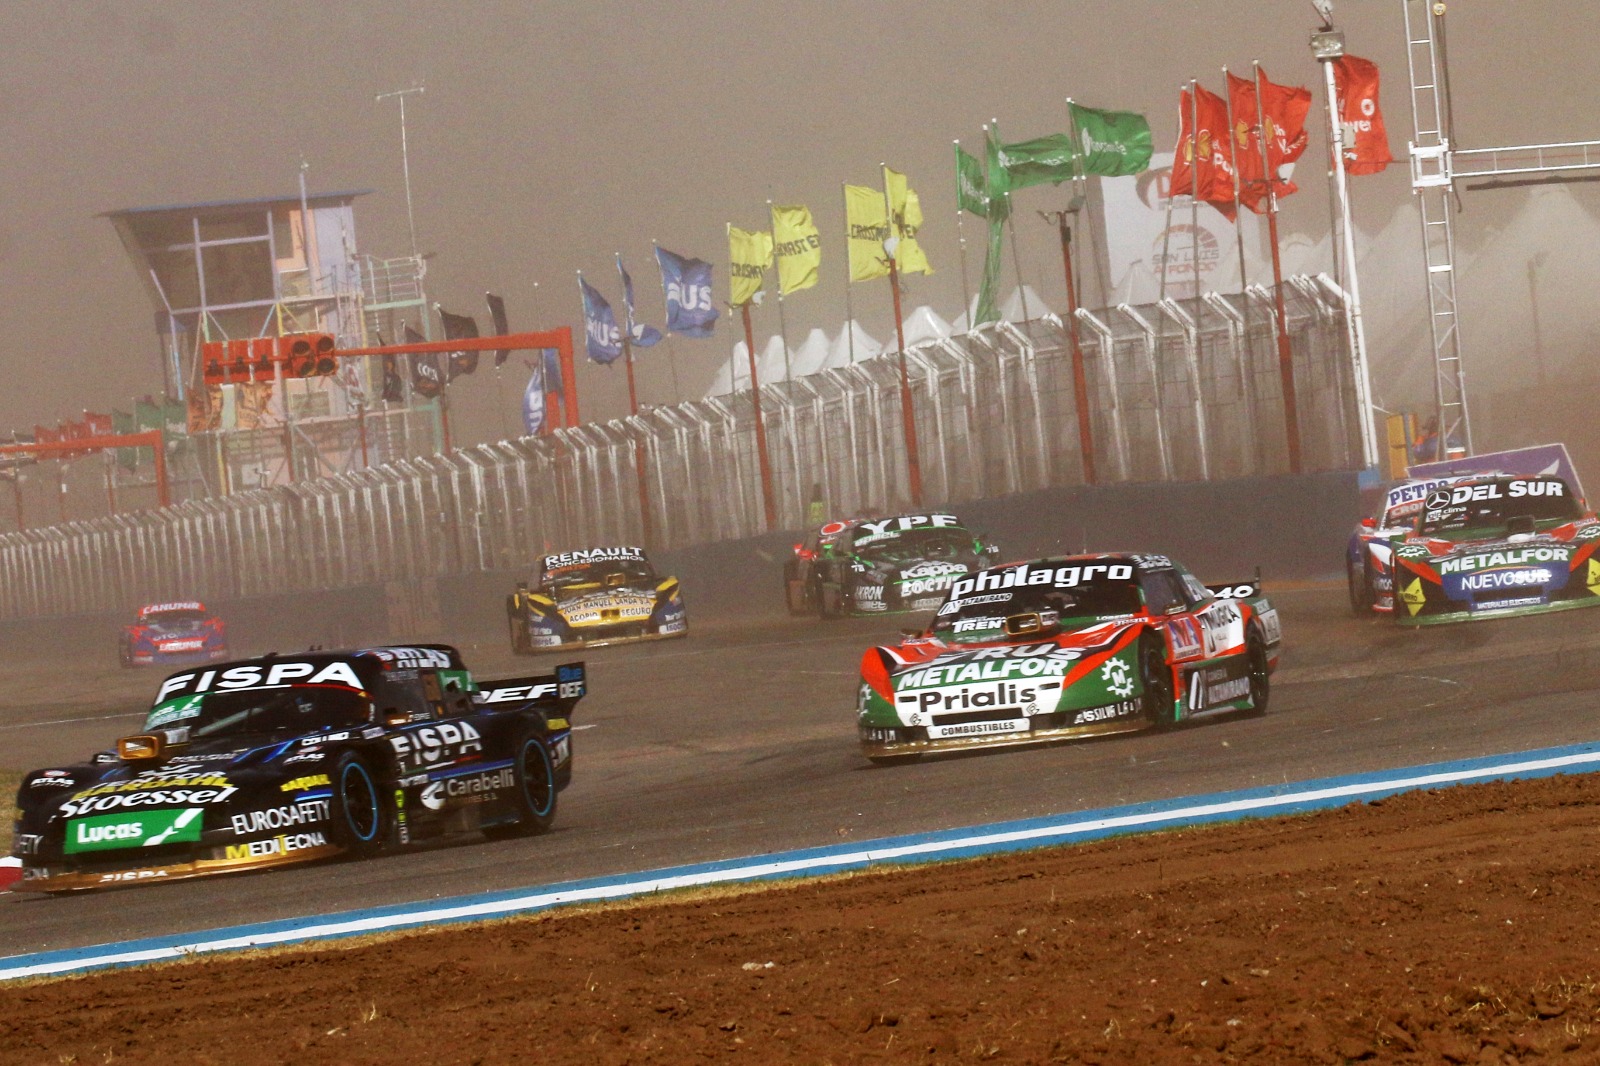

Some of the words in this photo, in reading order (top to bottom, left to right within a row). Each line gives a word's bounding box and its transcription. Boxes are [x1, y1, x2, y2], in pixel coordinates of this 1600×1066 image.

[1452, 485, 1502, 504] DEL
[1509, 481, 1563, 497] SUR
[861, 515, 957, 535] YPF
[546, 547, 642, 567] RENAULT
[547, 555, 645, 570] CONCESIONARIOS
[1441, 548, 1569, 575] METALFOR
[900, 564, 968, 580] Kappa
[951, 565, 1132, 601] philagro
[1206, 585, 1254, 599] 40
[563, 605, 581, 614] JUAN
[583, 599, 612, 609] MANUEL
[615, 598, 637, 606] LANDA
[962, 592, 1012, 606] ALTAMIRANO
[1477, 599, 1508, 609] MATERIALES
[569, 612, 598, 622] ACOPIO
[154, 661, 364, 706] FISPA
[898, 658, 1069, 691] METALFOR
[479, 683, 557, 703] EF
[941, 721, 1015, 736] COMBUSTIBLES
[389, 721, 483, 765] FISPA
[447, 768, 514, 796] Carabelli
[59, 787, 239, 818] Stoessel
[231, 800, 331, 835] EUROSAFETY
[78, 821, 142, 843] Lucas
[225, 831, 327, 860] MEDITECNA
[100, 870, 168, 882] FISPA
